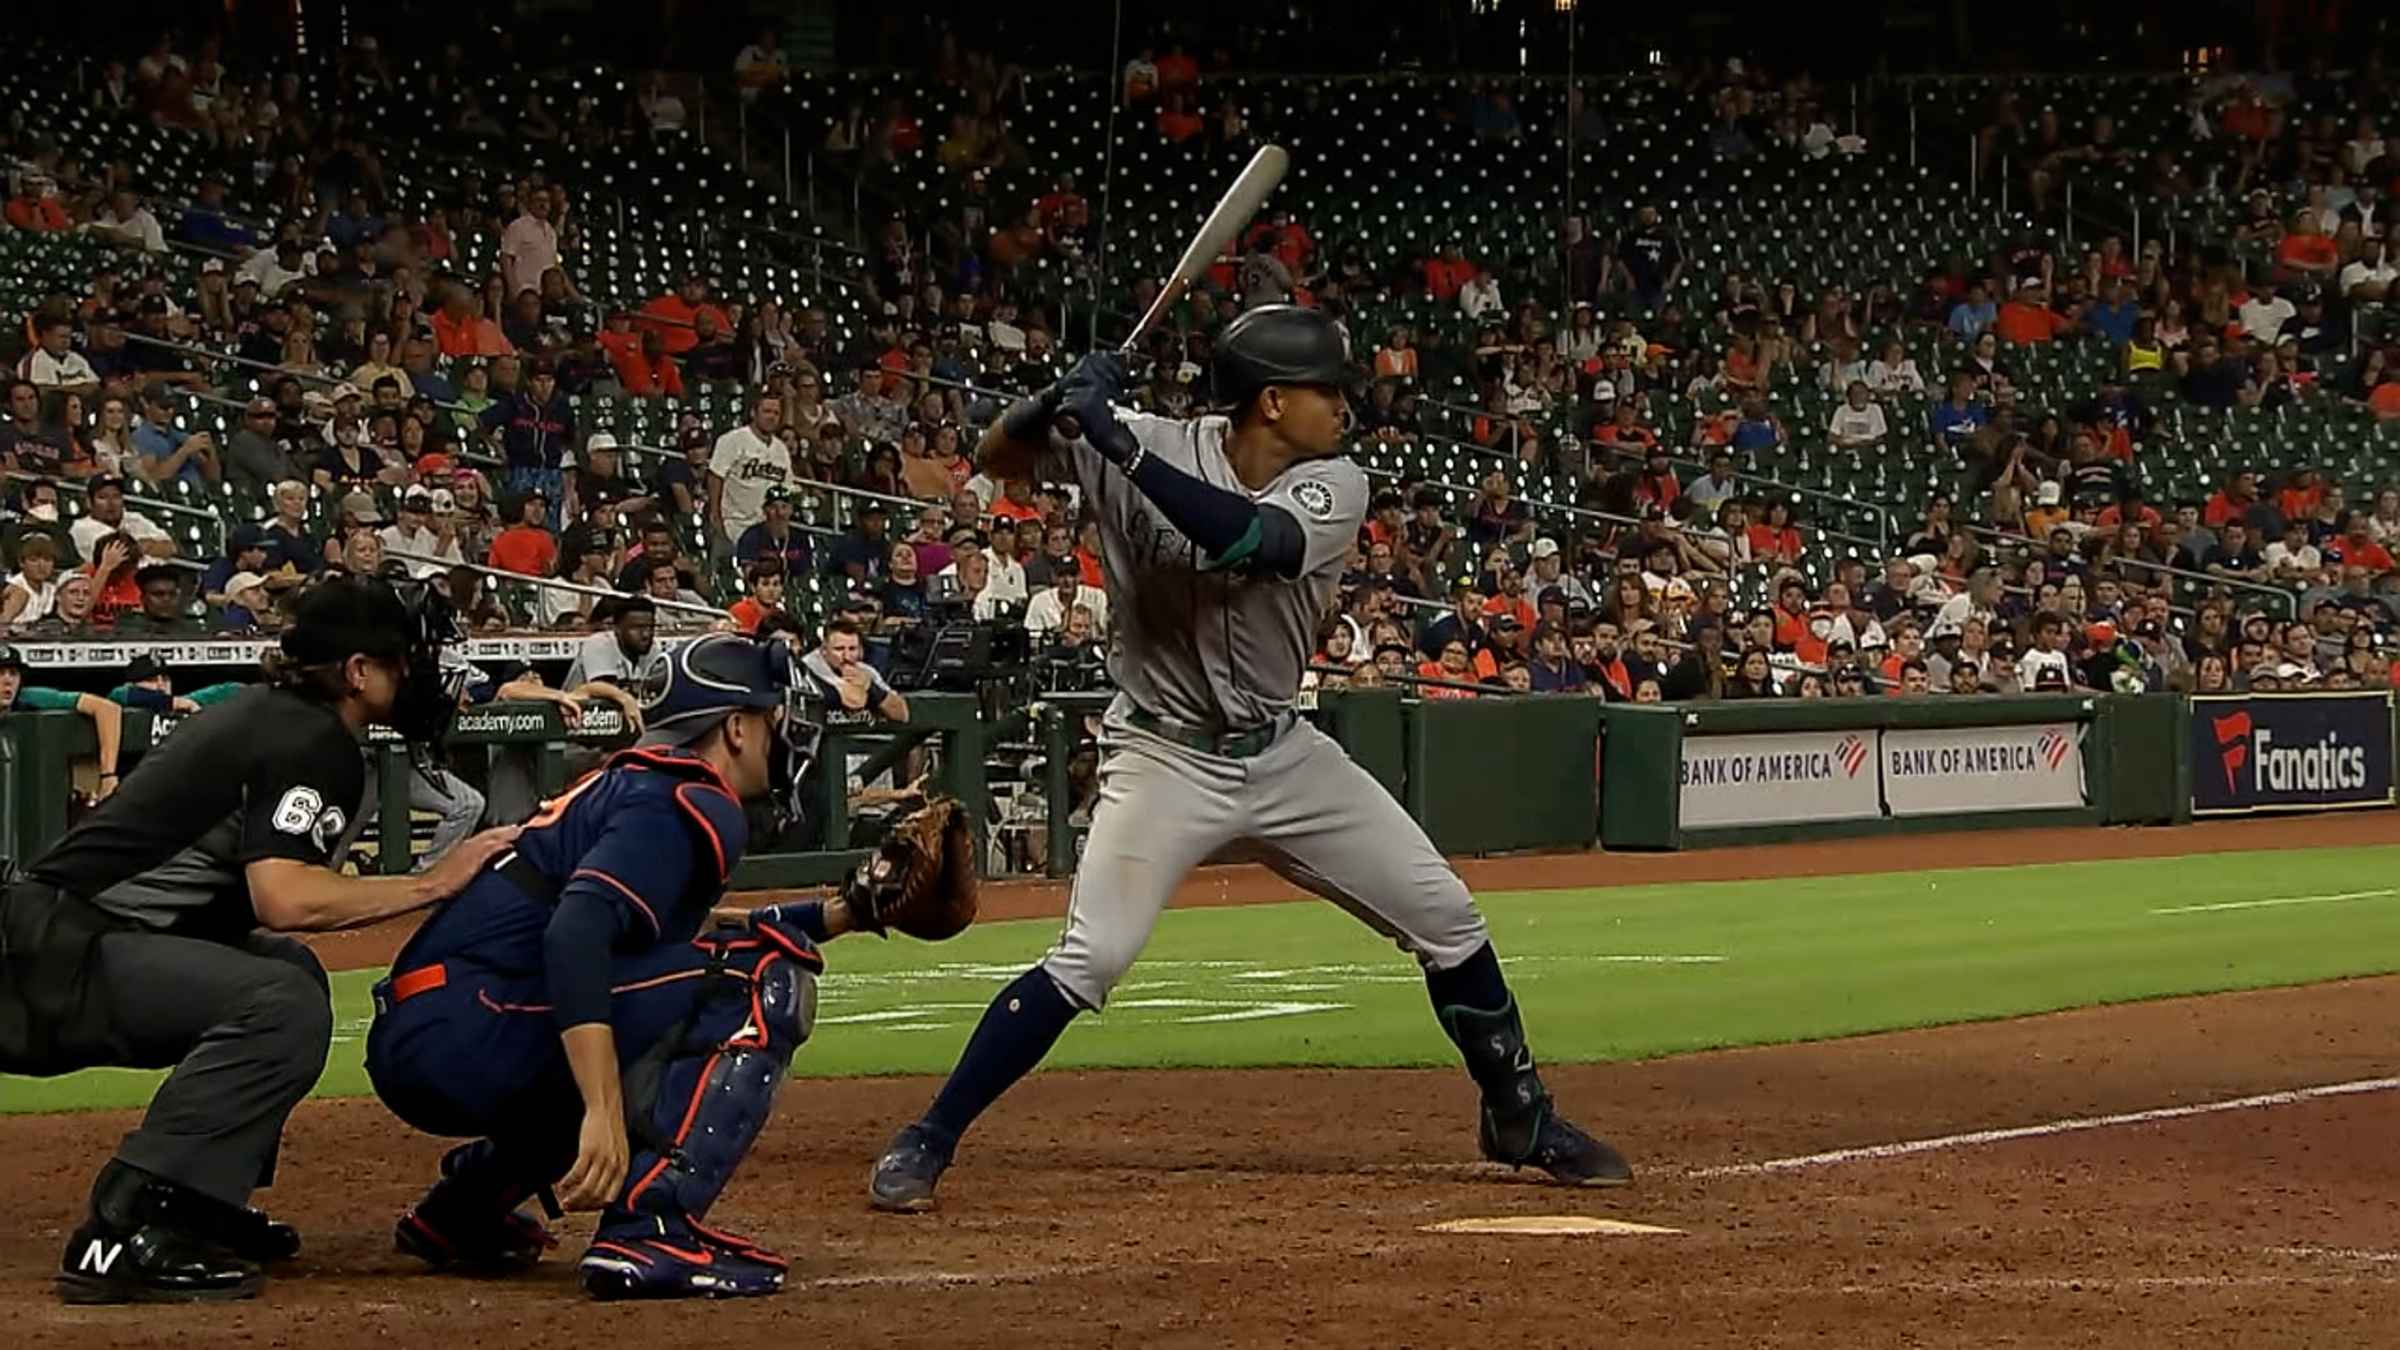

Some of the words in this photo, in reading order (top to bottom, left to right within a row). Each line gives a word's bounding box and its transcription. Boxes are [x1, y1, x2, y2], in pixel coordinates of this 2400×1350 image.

[457, 711, 544, 736] academy.com
[1681, 757, 1727, 786] BANK
[1731, 754, 1753, 783] OF
[1756, 752, 1833, 783] AMERICA
[1891, 750, 1937, 776] BANK
[1941, 748, 1960, 774] OF
[1964, 746, 2036, 773] AMERICA
[2254, 728, 2366, 791] Fanatics
[78, 1238, 123, 1275] N
